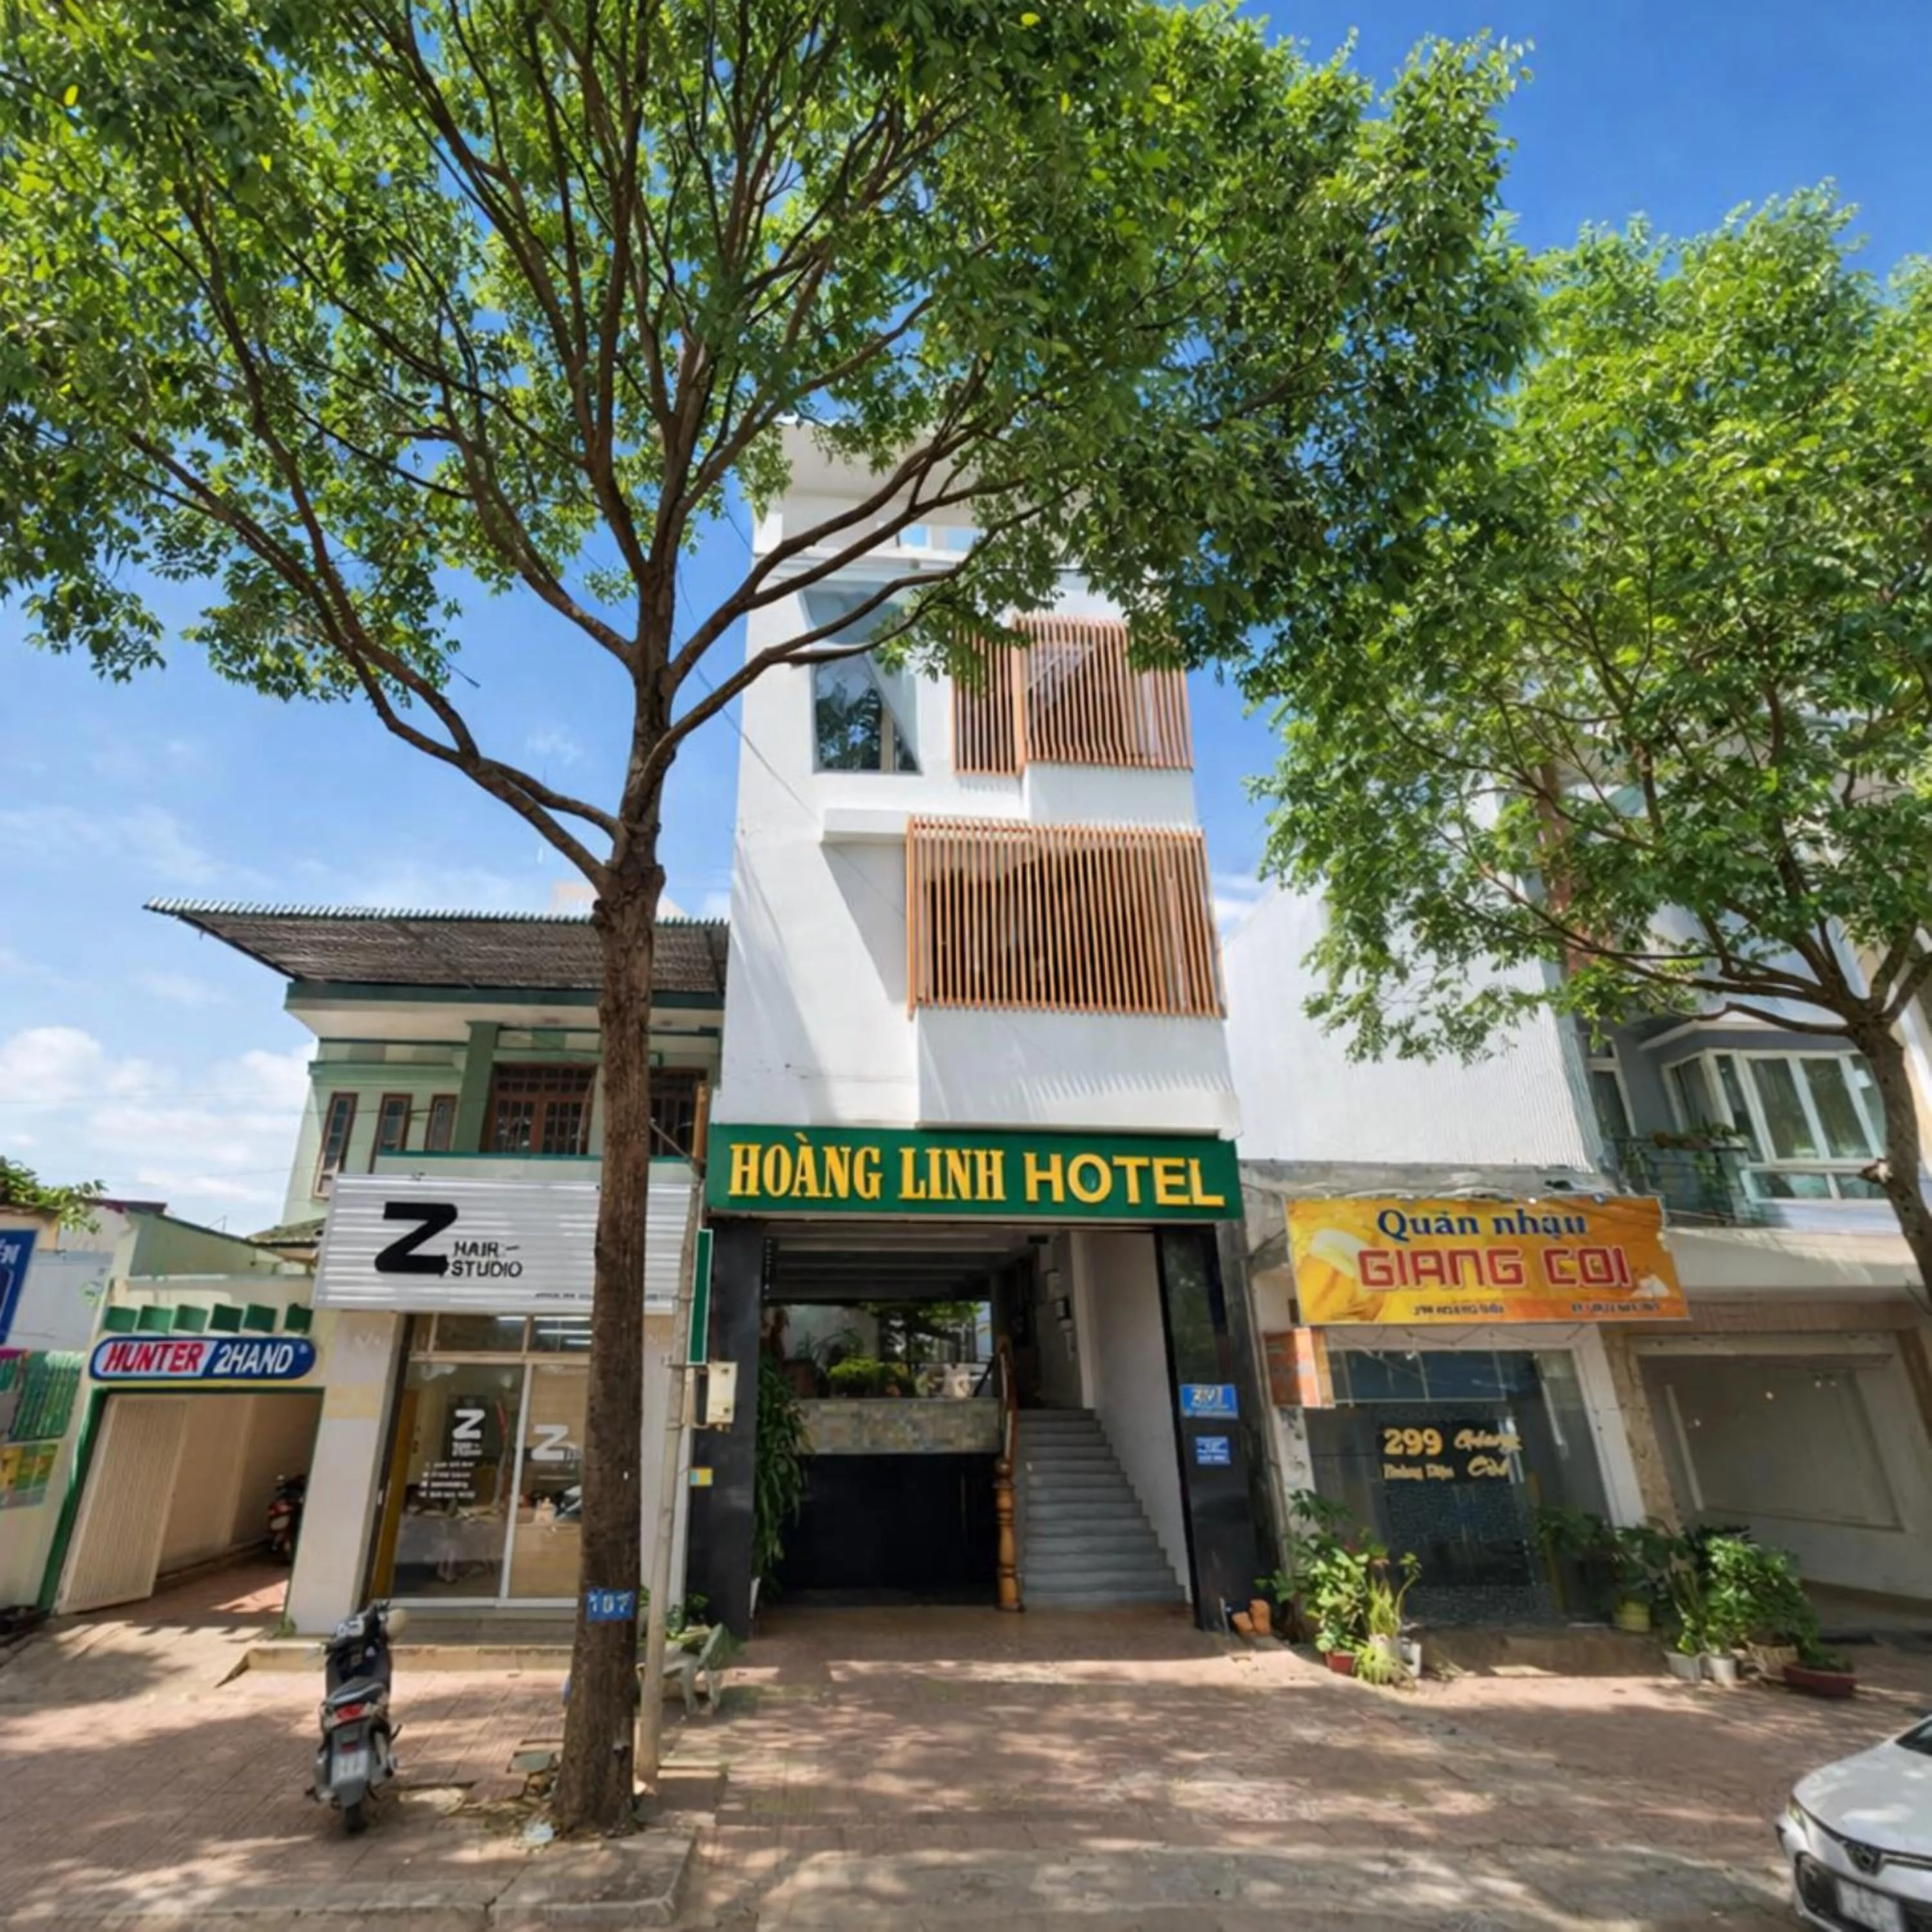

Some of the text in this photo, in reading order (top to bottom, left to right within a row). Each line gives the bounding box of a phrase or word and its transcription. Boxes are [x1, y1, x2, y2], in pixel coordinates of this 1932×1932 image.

[728, 1132, 1226, 1208] HOÀNG LINH HOTEL
[374, 1202, 459, 1278] Z
[454, 1240, 500, 1258] HAIR
[451, 1259, 524, 1278] STUDIO
[1357, 1247, 1526, 1290] GIANG
[102, 1341, 294, 1374] HUNTER 2HAND
[453, 1408, 486, 1439] Z
[531, 1424, 569, 1461] Z
[1383, 1427, 1443, 1457] 299
